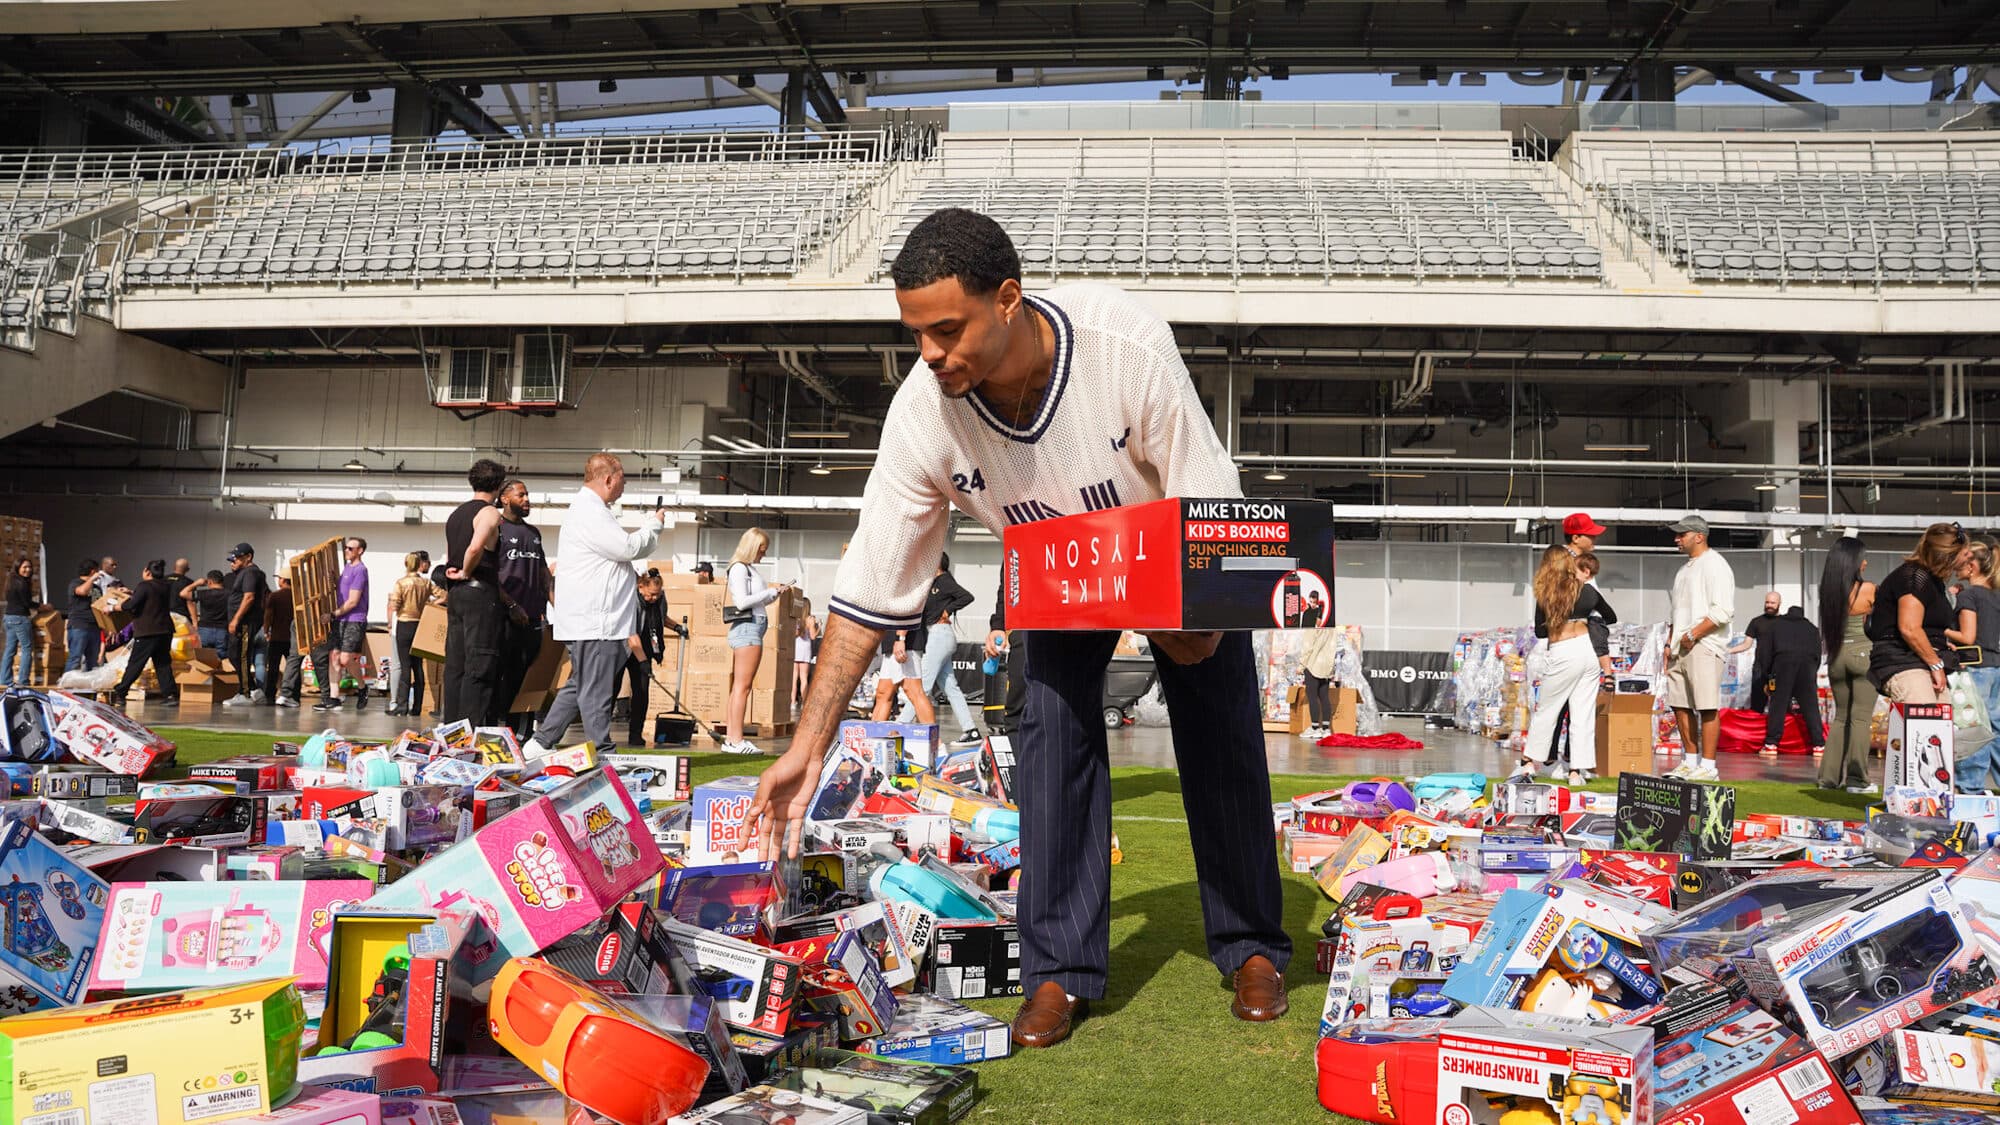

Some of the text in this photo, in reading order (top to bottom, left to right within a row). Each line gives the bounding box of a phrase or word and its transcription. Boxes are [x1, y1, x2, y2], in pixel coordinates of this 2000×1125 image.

[952, 467, 986, 494] 24
[1188, 502, 1286, 520] MIKE TYSON
[1188, 523, 1287, 539] KID'S BOXING
[1045, 530, 1147, 570] TYSON
[1188, 543, 1287, 557] PUNCHING BAG
[1188, 557, 1211, 569] SET
[1061, 575, 1127, 604] MIKE
[1370, 669, 1398, 679] BMO
[711, 799, 750, 821] Kid'
[1634, 787, 1680, 806] STRIKER-X
[587, 807, 613, 833] STOP
[591, 824, 631, 860] CREAM
[537, 849, 564, 885] ICE
[610, 847, 634, 866] ICE
[507, 861, 541, 906] STOP
[515, 842, 564, 910] CREAM
[912, 914, 926, 946] WARS
[918, 915, 931, 948] STAR
[1531, 912, 1566, 960] SONIC
[600, 934, 618, 973] BUGATTI
[701, 946, 731, 958] AVENTADOR
[730, 952, 757, 965] ROADSTER
[1782, 936, 1819, 968] POLICE
[1809, 929, 1853, 964] PURSUIT
[435, 978, 444, 1001] STUNT
[230, 1008, 255, 1025] 3+
[433, 1003, 442, 1036] CONTROL
[431, 1037, 440, 1067] REMOTE
[1443, 1055, 1540, 1085] TRANSFORMERS
[1574, 1061, 1613, 1075] WARNING:
[208, 1088, 256, 1104] WARNING:
[949, 1085, 973, 1112] HORNET
[1807, 1097, 1833, 1112] WORLD
